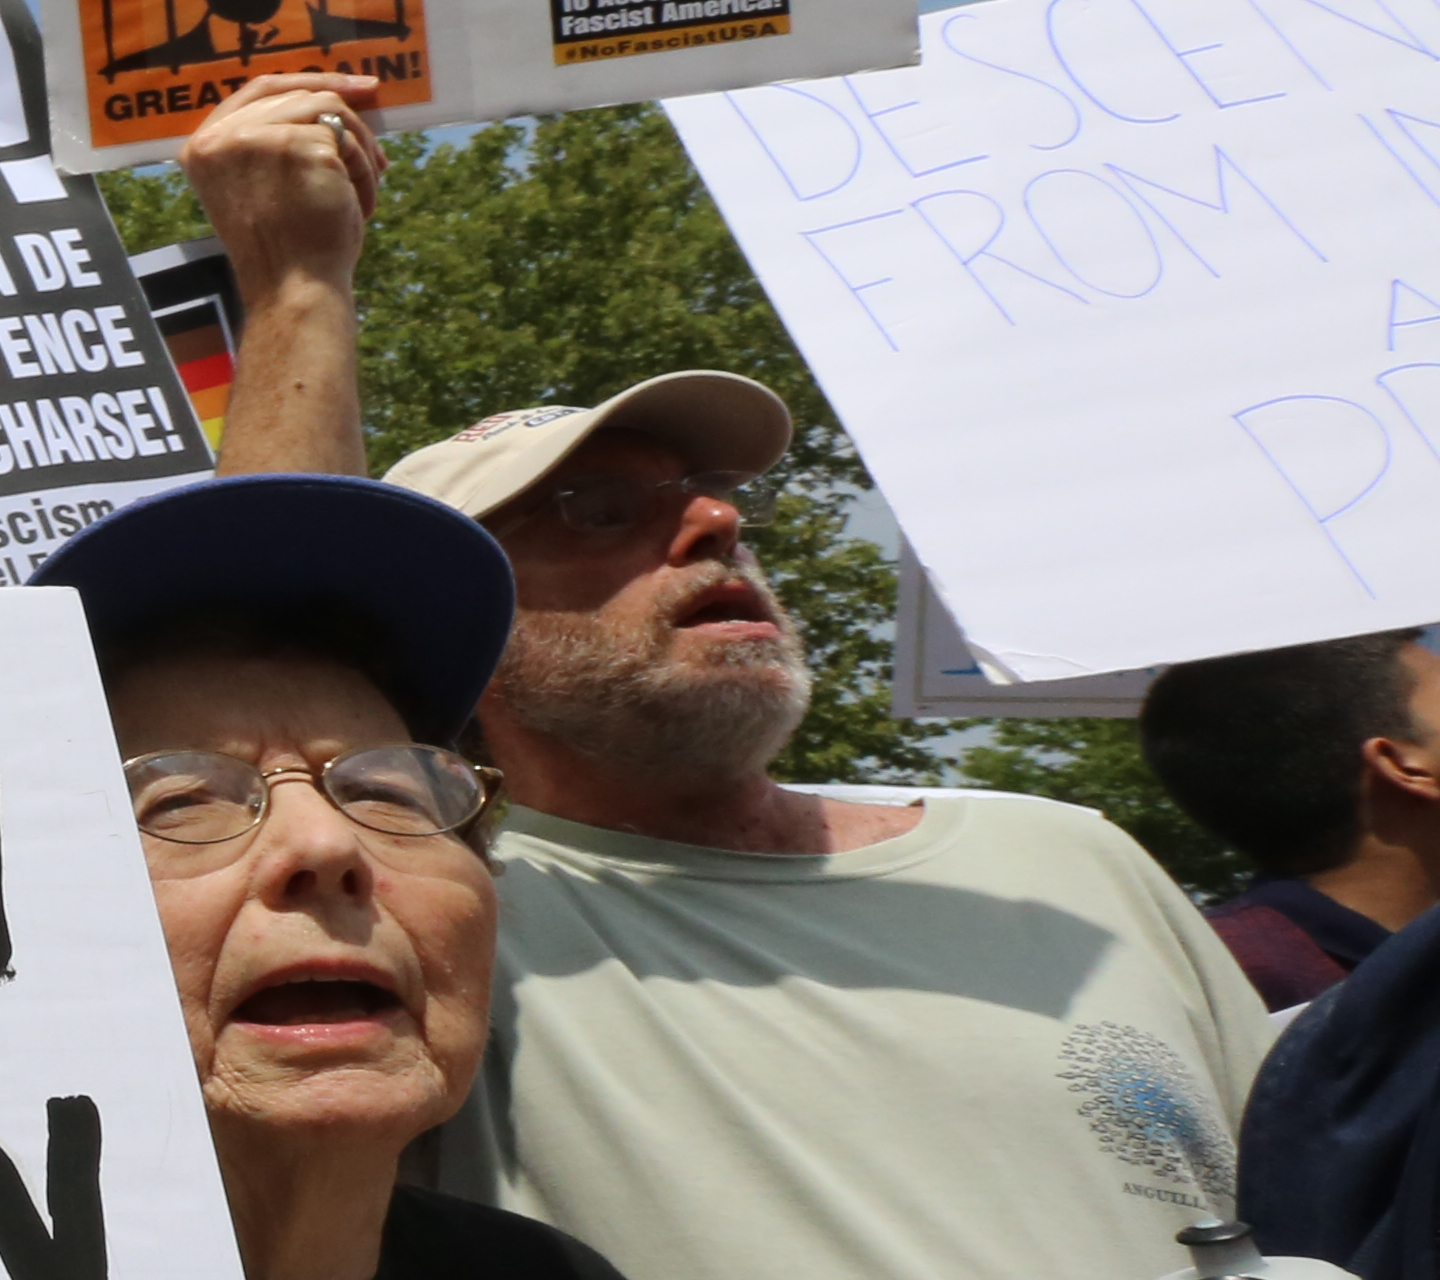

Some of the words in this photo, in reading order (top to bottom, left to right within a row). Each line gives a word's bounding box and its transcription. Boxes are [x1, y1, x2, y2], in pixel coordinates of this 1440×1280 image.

[561, 7, 655, 36] Fascist
[565, 22, 778, 60] #NoFascistUSA
[15, 228, 101, 293] DE
[800, 144, 1330, 353] FROM
[1122, 1180, 1207, 1211] ANGUILL
